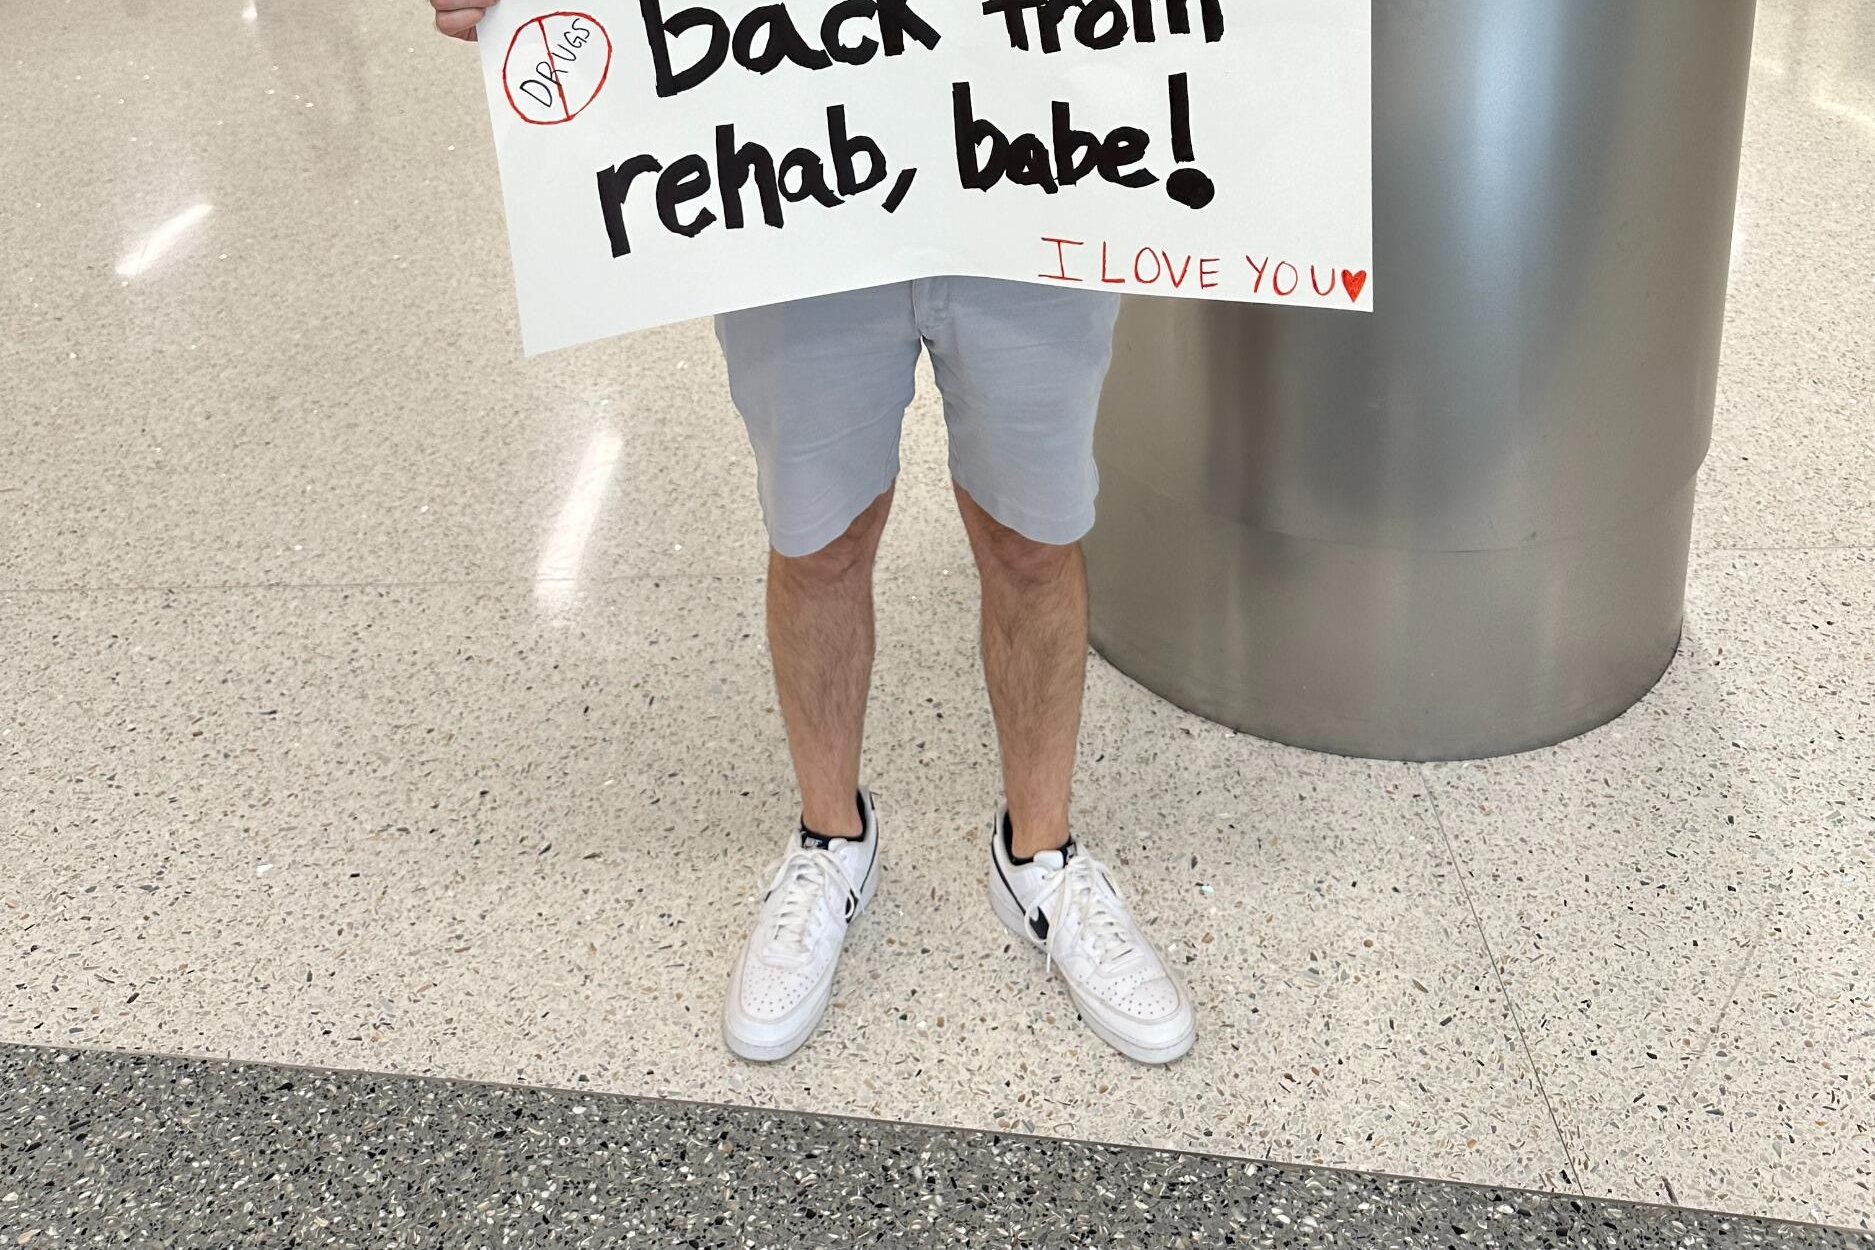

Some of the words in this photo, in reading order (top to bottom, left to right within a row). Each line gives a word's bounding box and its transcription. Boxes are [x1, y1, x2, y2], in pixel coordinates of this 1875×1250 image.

[519, 17, 591, 108] DRUGS
[597, 104, 918, 258] rehab,
[952, 72, 1216, 209] babe!
[1037, 237, 1084, 282] I
[1100, 240, 1221, 290] LOVE
[1245, 254, 1336, 297] YOU
